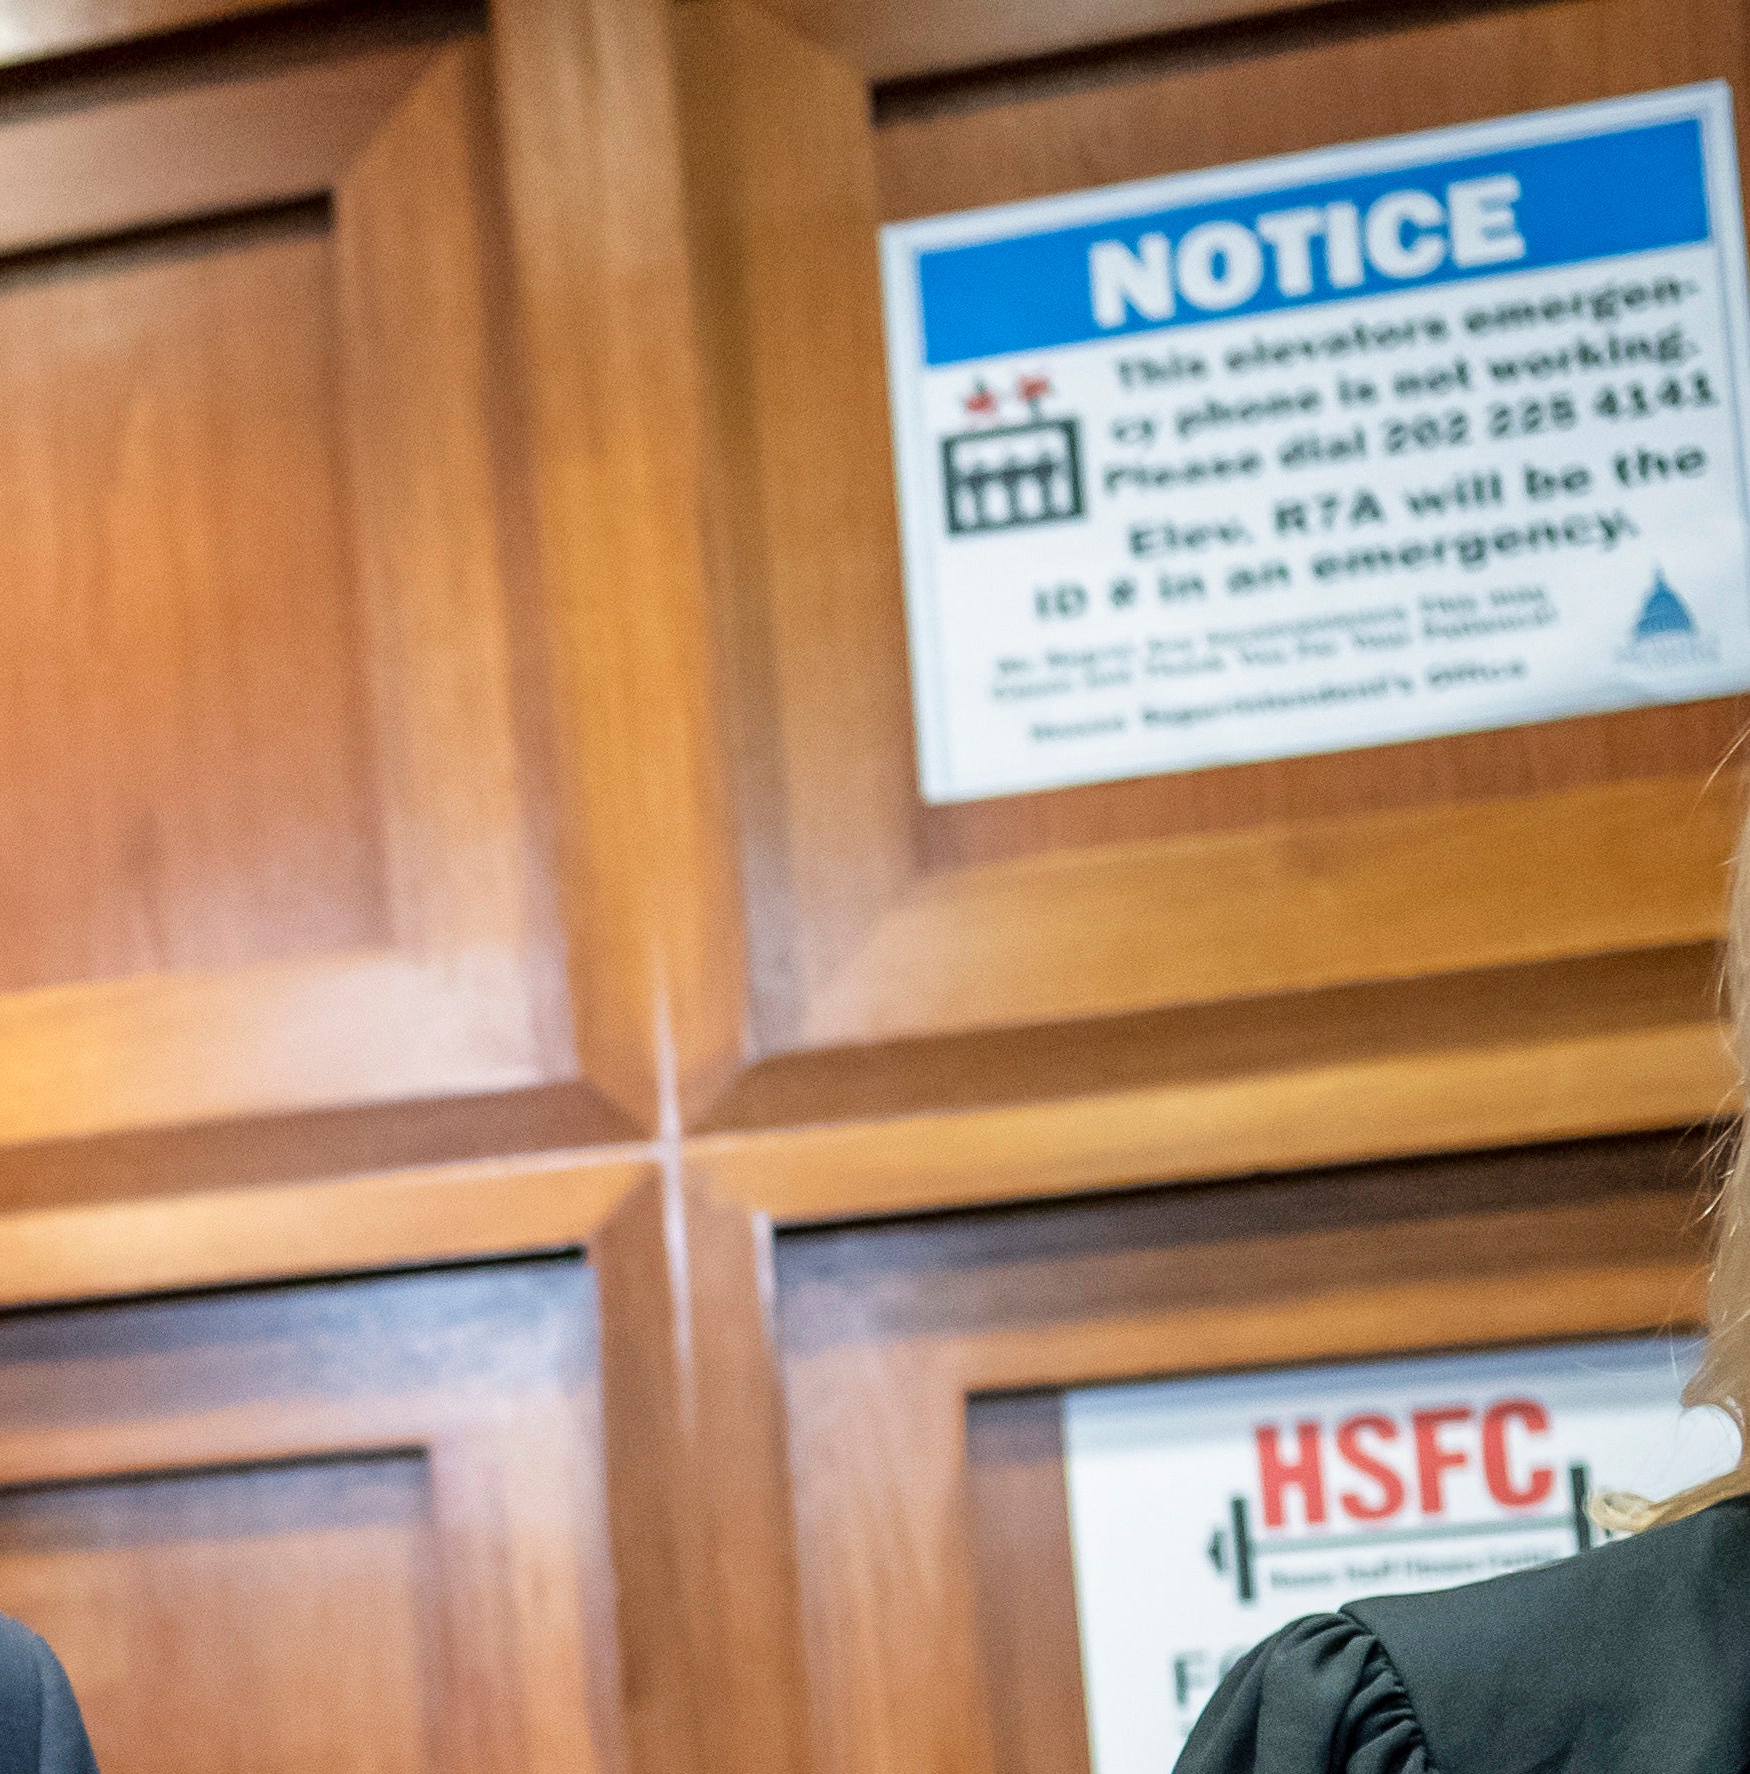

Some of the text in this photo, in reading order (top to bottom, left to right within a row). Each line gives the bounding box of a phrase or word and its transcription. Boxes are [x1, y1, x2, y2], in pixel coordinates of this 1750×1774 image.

[1089, 173, 1526, 328] NOTICE
[1110, 325, 1700, 446] cy phone is not working.
[1115, 278, 1699, 387] This elevators emergen-
[1103, 451, 1262, 494] Please
[1278, 426, 1365, 468] dial
[1383, 408, 1468, 454] 202
[1594, 369, 1720, 420] 4141
[1035, 582, 1089, 619] ID
[1157, 570, 1205, 604] in
[1224, 561, 1291, 597] an
[1310, 505, 1642, 581] emergency.
[1128, 515, 1253, 561] Elev.
[1402, 472, 1503, 517] will
[1524, 462, 1591, 500] be
[1611, 446, 1705, 487] the
[1254, 1397, 1554, 1528] HSFC
